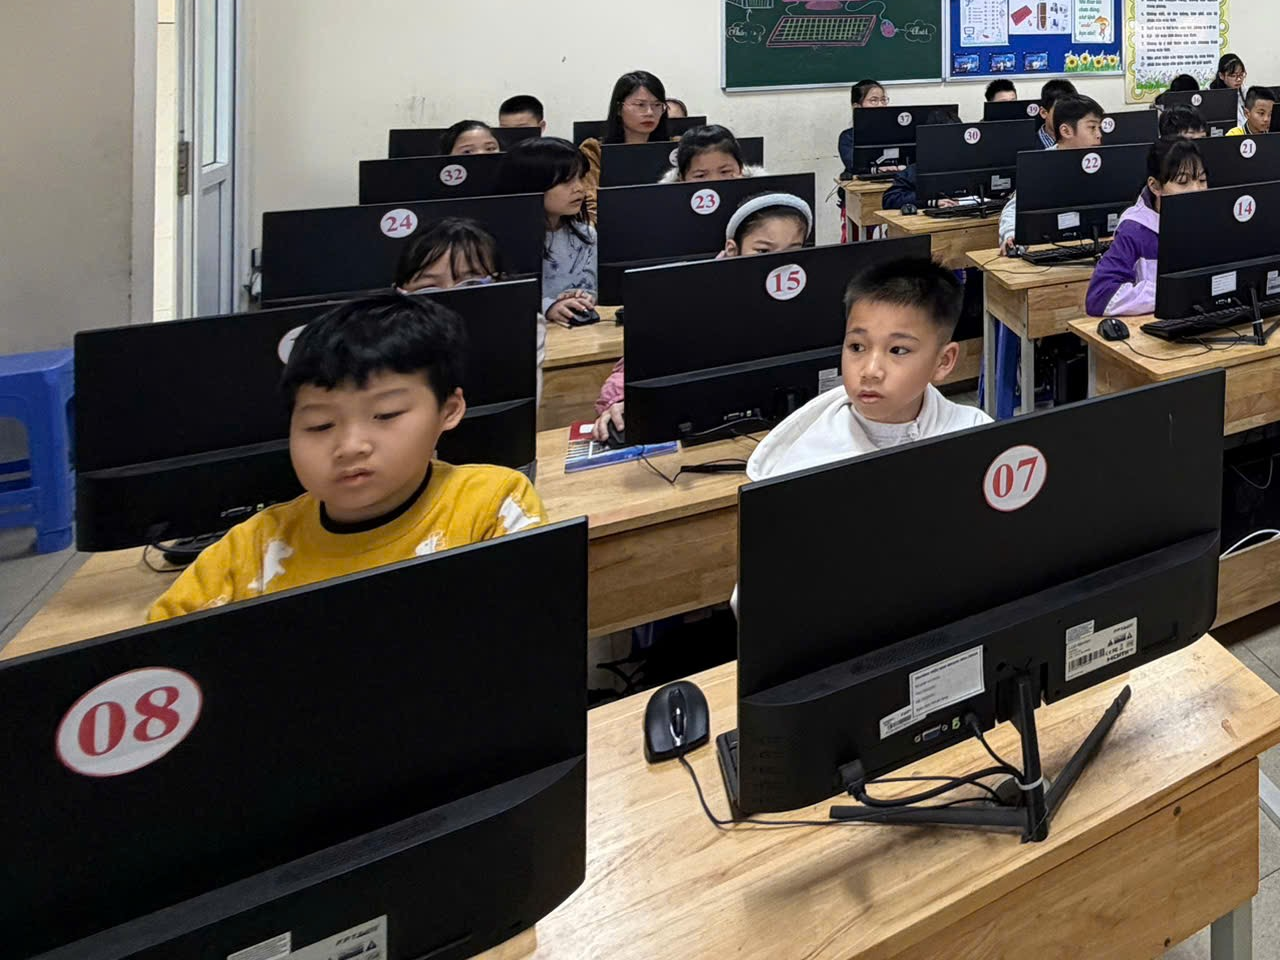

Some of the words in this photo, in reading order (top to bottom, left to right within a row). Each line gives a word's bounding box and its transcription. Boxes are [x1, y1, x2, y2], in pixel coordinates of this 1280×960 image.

[1103, 121, 1113, 129] 29
[966, 131, 978, 140] 30
[1242, 143, 1253, 153] 21
[1084, 157, 1098, 169] 22
[445, 168, 463, 181] 32
[694, 194, 715, 209] 23
[1237, 200, 1252, 216] 14
[386, 214, 412, 232] 24
[773, 271, 800, 293] 15
[991, 455, 1039, 499] 07
[77, 685, 180, 757] 08
